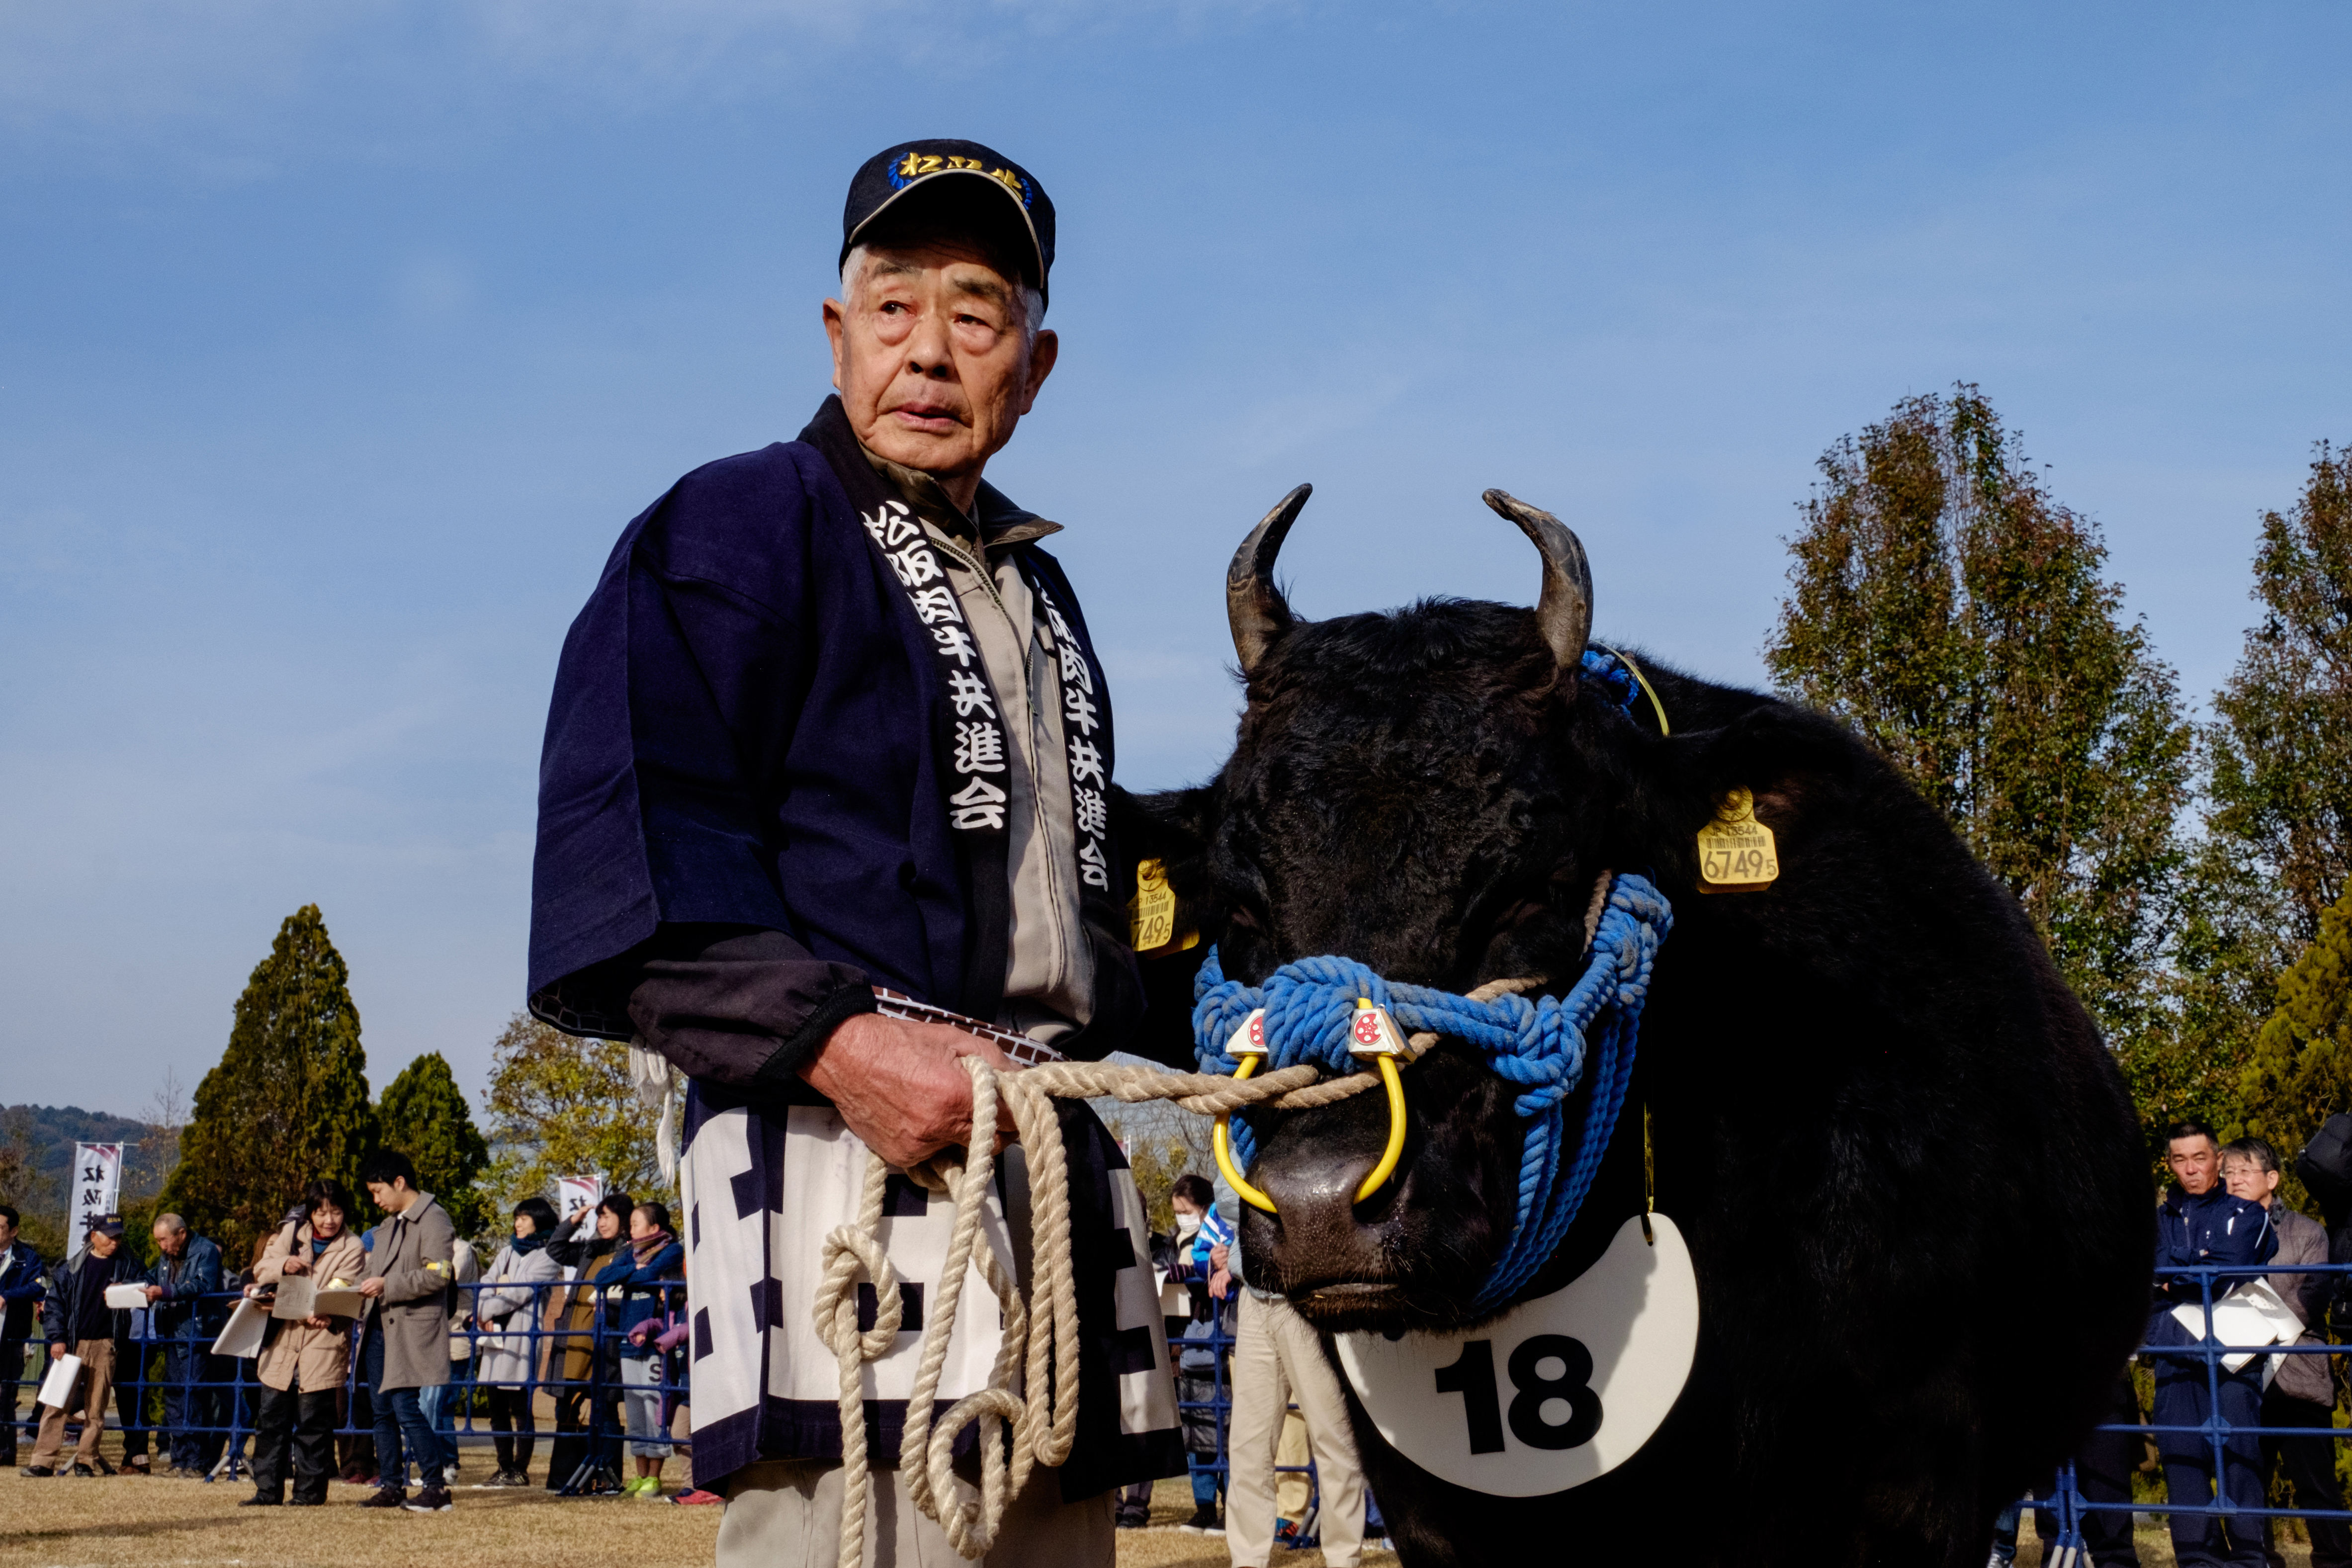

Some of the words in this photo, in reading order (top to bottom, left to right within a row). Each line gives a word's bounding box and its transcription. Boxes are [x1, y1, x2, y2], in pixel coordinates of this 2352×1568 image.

[861, 500, 1006, 829] 松阪肉牛共進会
[1145, 891, 1166, 905] 13544
[1435, 1334, 1604, 1455] 18
